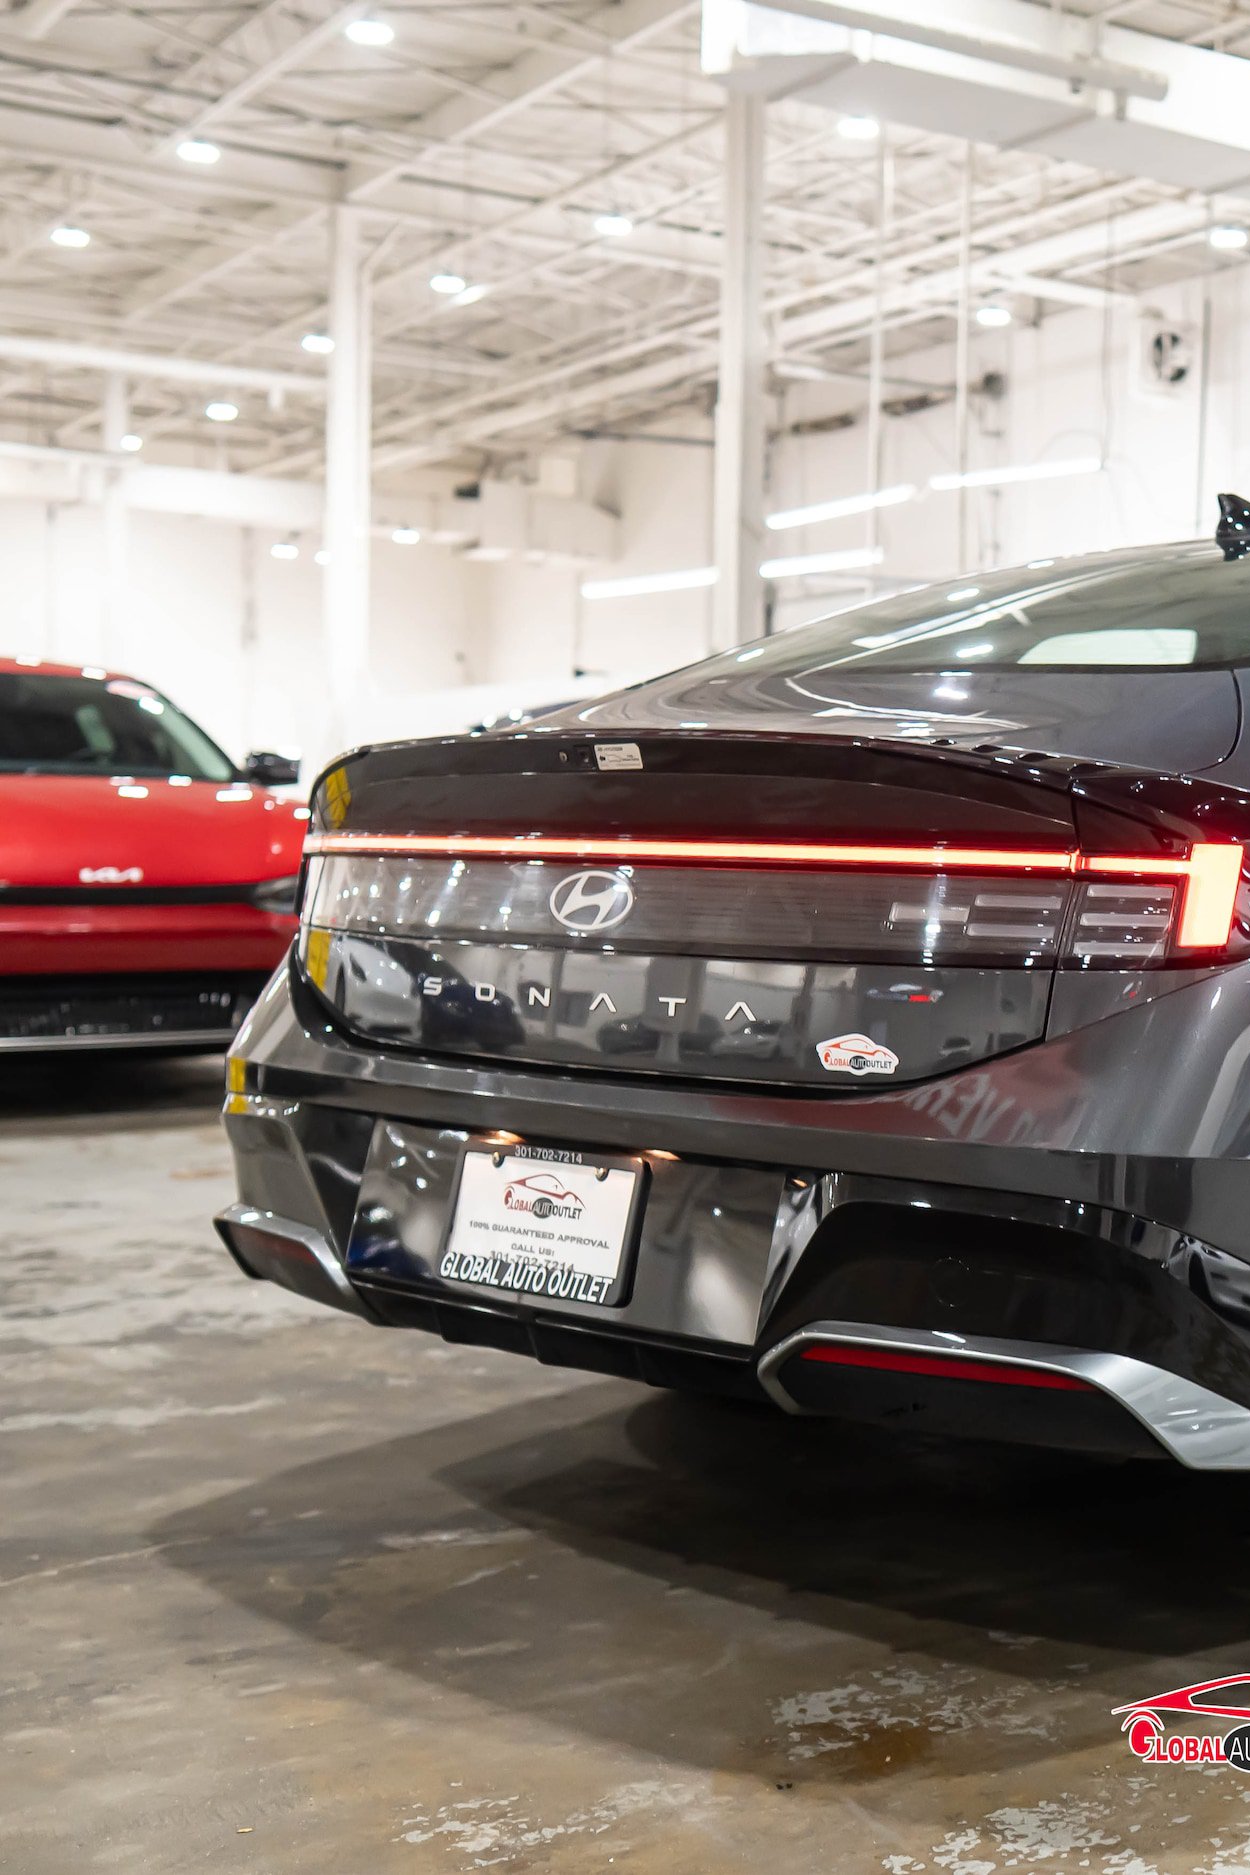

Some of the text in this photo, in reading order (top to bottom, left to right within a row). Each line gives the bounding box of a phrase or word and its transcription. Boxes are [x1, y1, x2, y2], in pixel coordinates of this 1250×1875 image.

[423, 976, 757, 1022] SONATA
[514, 1144, 583, 1165] 301-702-7214
[469, 1220, 611, 1250] 100% GUARANTEED APPROVAL
[511, 1242, 535, 1254] CALL
[440, 1251, 614, 1304] GLOBAL AUTO OUTLET
